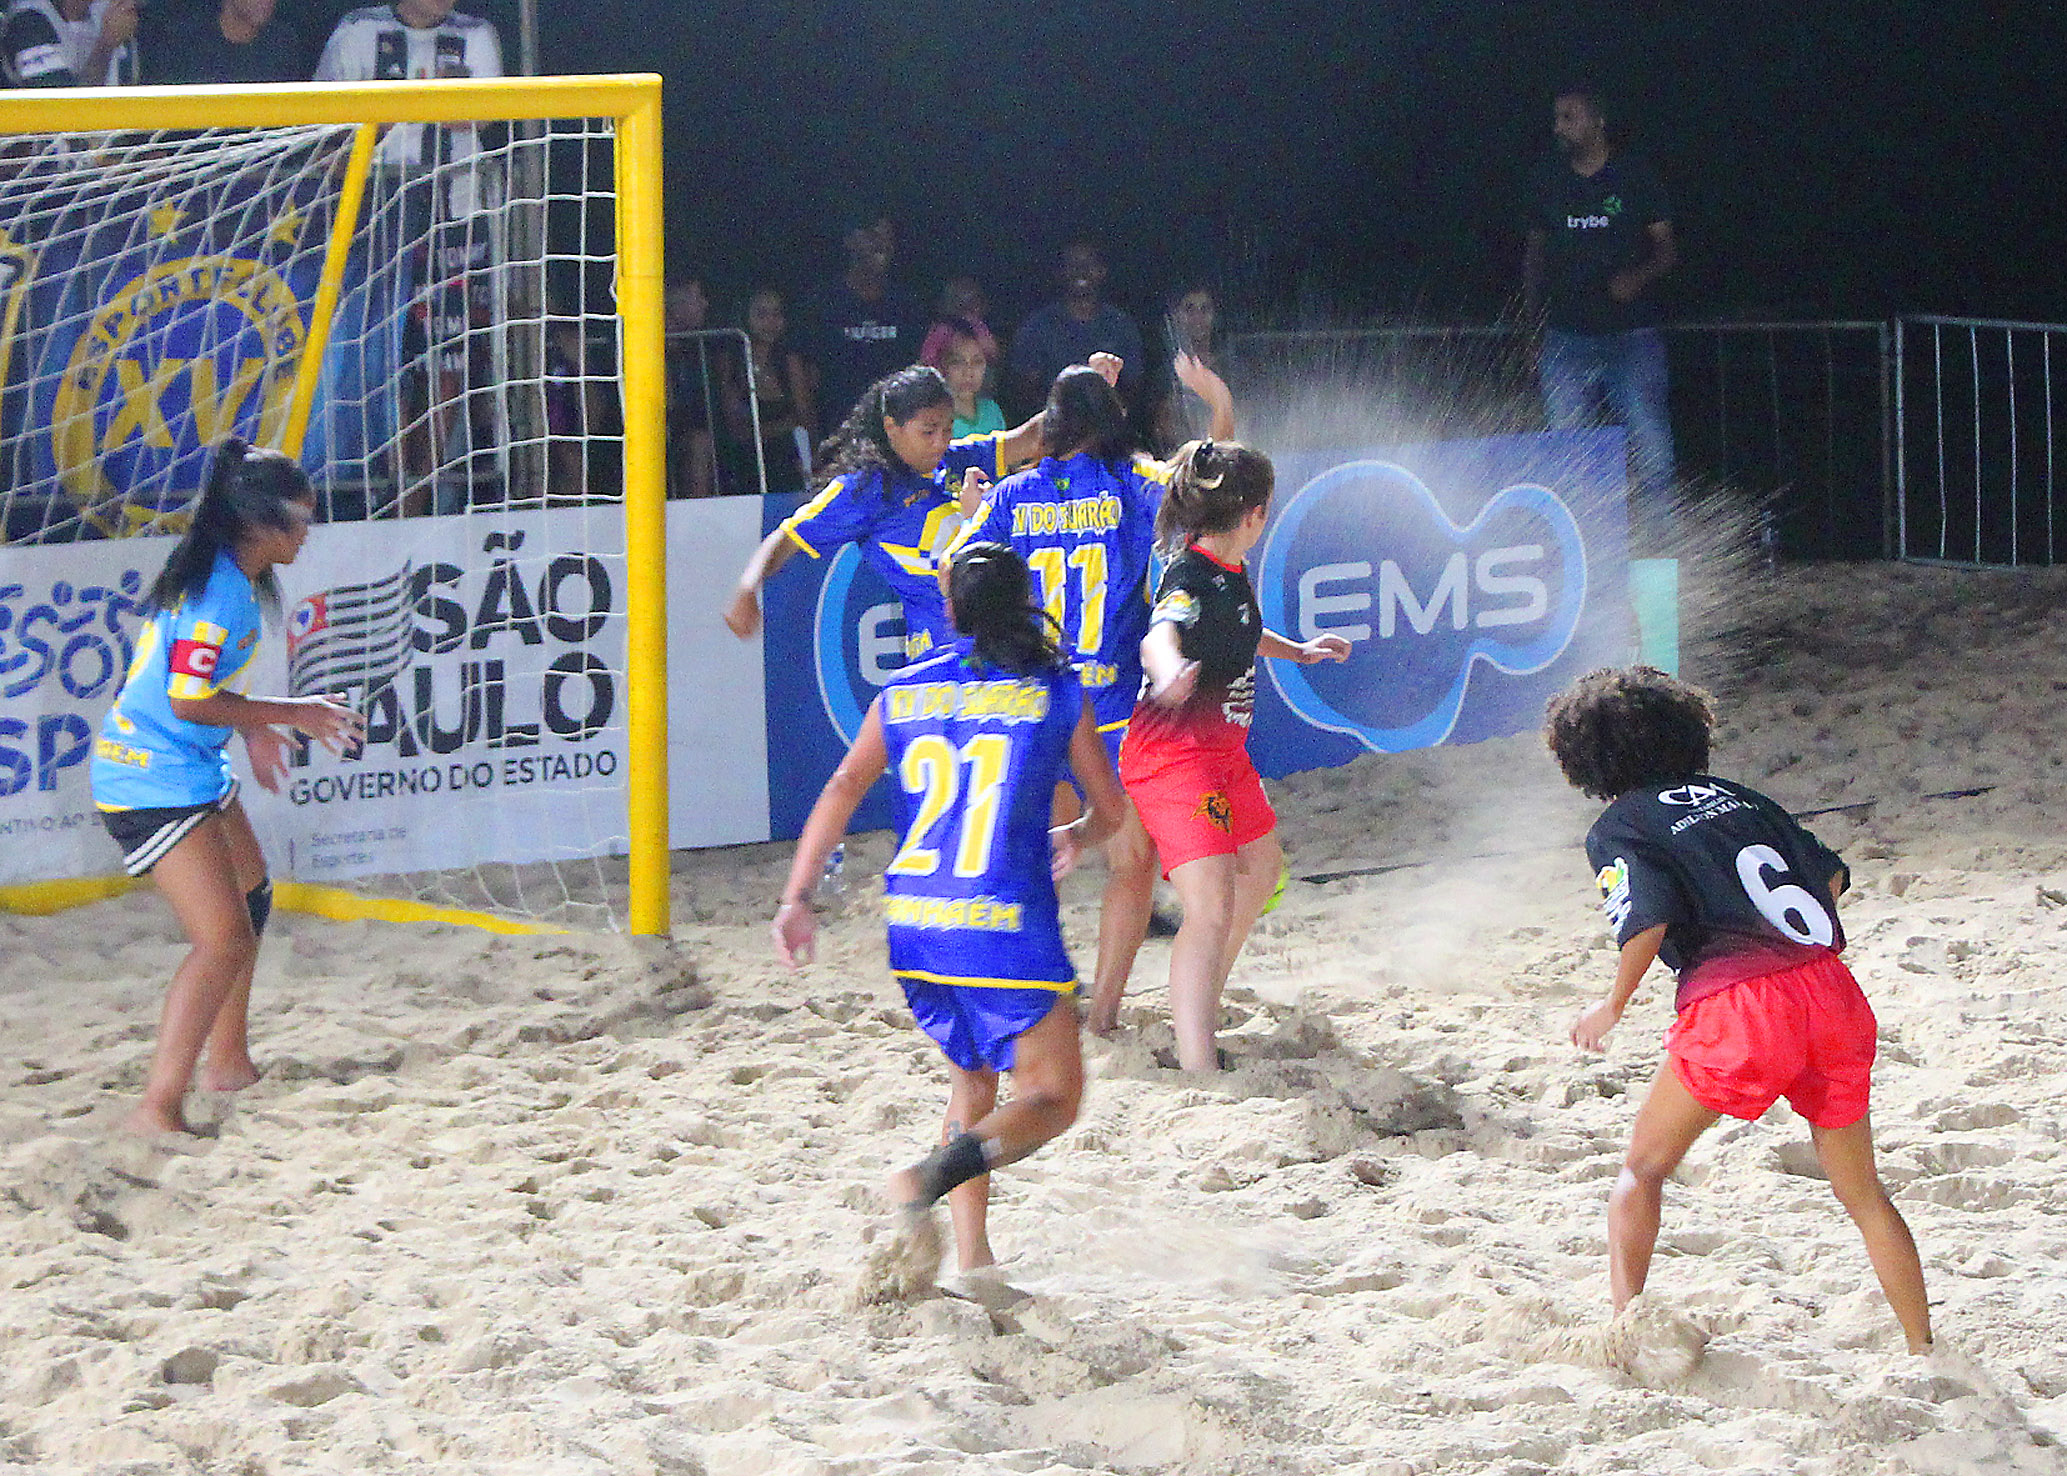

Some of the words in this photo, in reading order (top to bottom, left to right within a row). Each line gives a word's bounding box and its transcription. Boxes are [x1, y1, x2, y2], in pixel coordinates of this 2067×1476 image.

[1567, 214, 1609, 230] trybe
[1030, 502, 1059, 535] DO
[410, 530, 612, 654] SÃO
[1028, 543, 1109, 655] 11
[1299, 545, 1548, 641] EMS
[189, 647, 218, 673] C
[290, 651, 615, 767] AULO
[289, 765, 443, 805] GOVERNO
[449, 762, 494, 791] DO
[503, 750, 617, 786] ESTADO
[888, 733, 1013, 878] 21
[1736, 844, 1833, 947] 6
